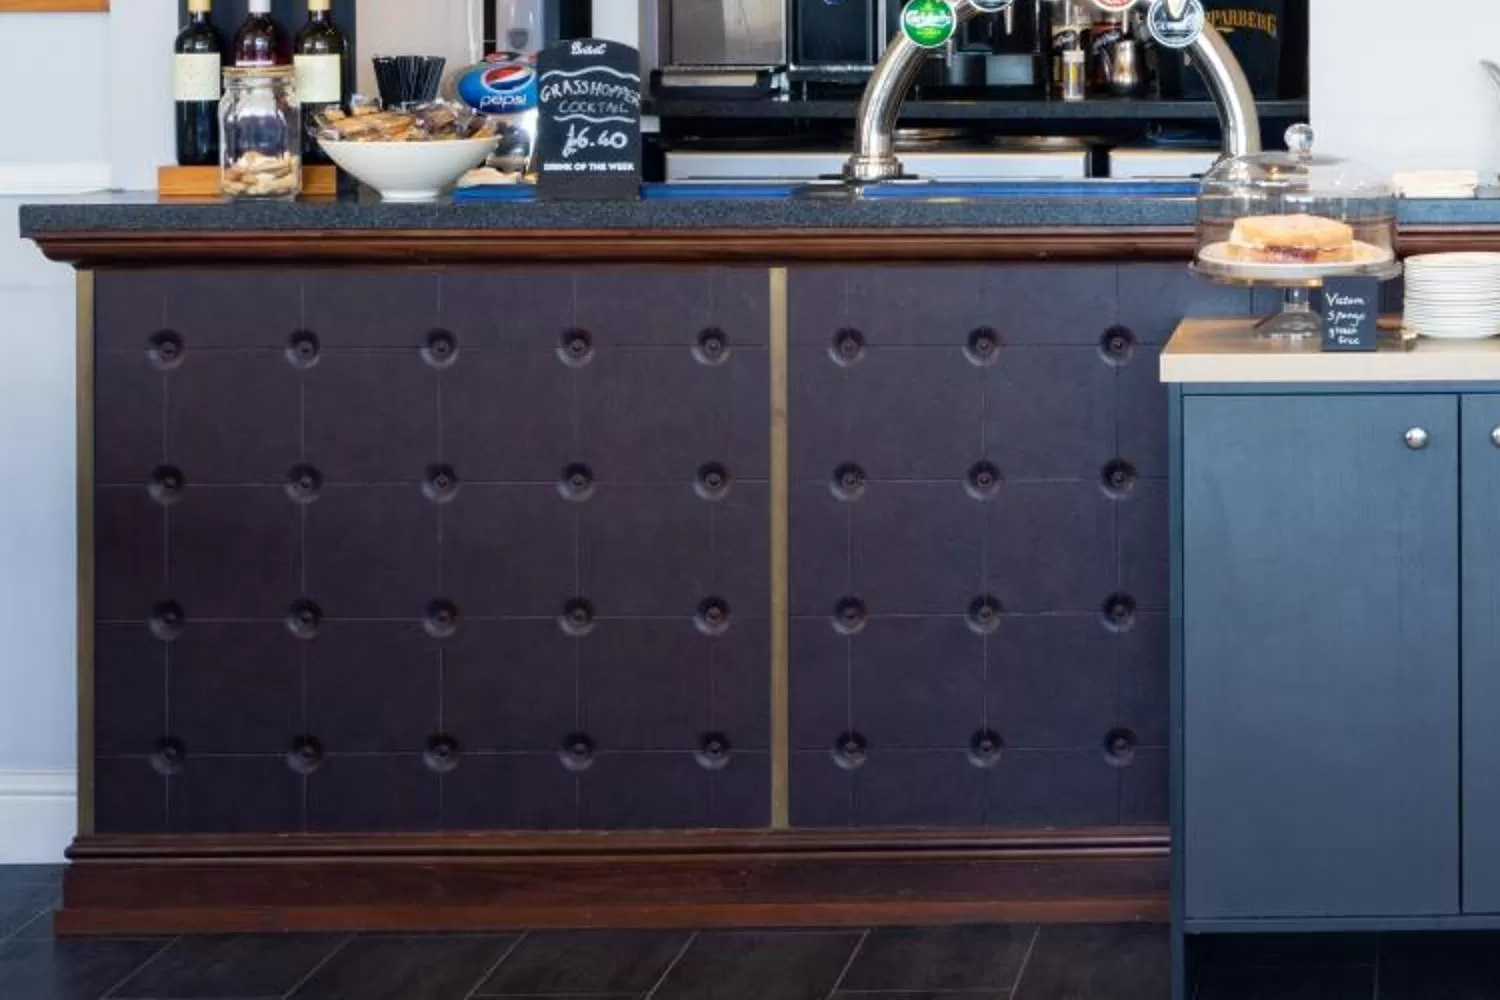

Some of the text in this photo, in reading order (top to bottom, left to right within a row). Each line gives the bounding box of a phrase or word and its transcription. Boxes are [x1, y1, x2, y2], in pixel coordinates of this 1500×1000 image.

[479, 93, 527, 109] pepsi
[541, 79, 640, 108] GRASSHOPPER
[562, 123, 628, 158] £6.40
